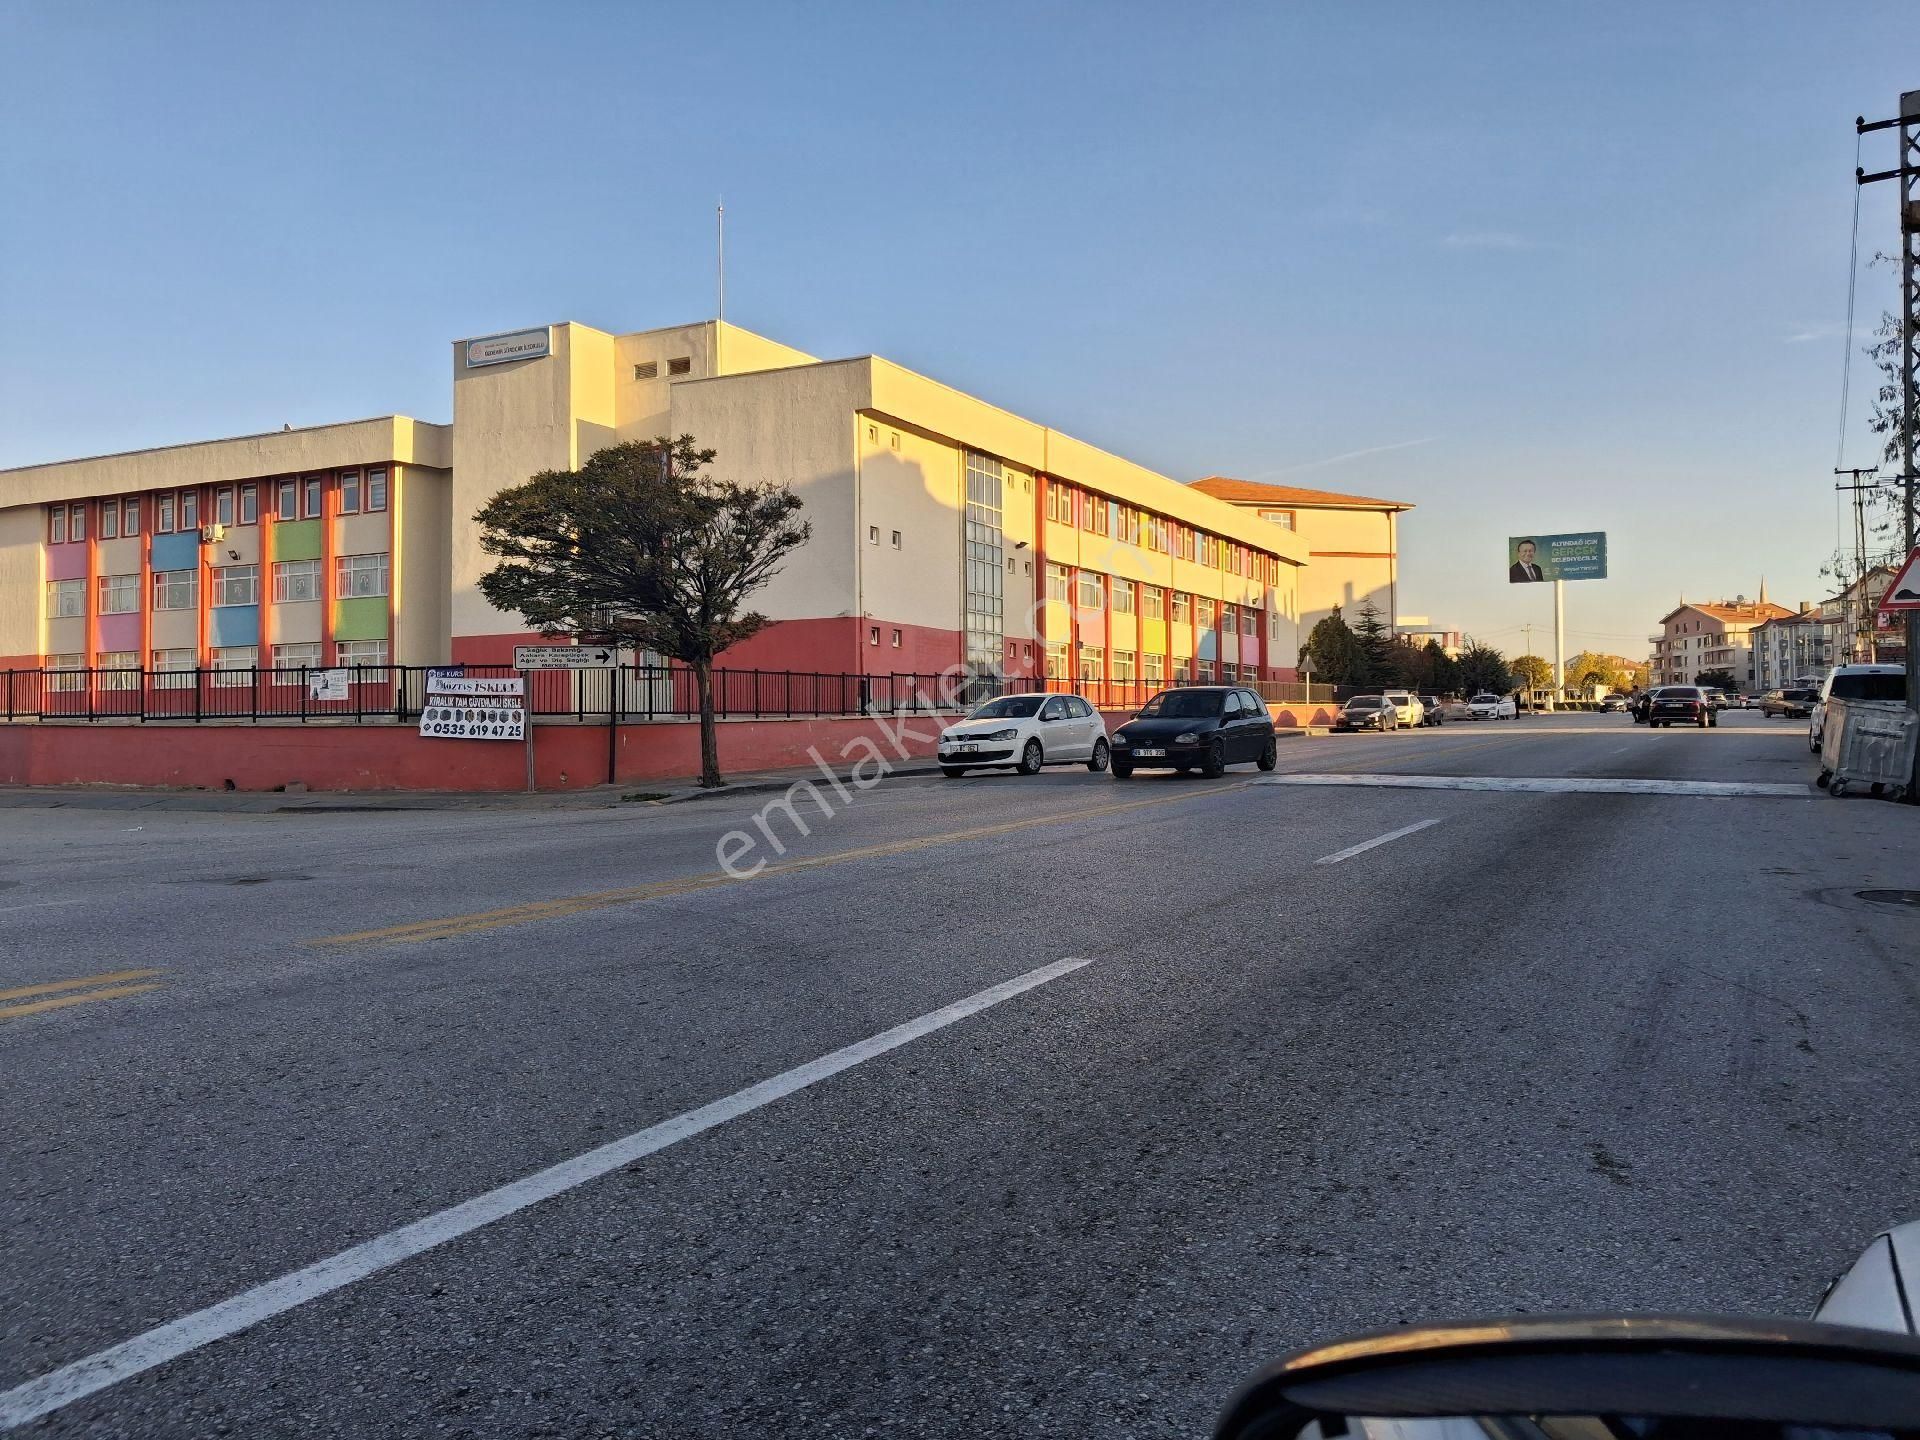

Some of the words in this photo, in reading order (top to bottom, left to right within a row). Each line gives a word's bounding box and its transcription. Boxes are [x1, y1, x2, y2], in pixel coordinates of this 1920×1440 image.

[474, 680, 518, 693] İSKELE
[433, 723, 466, 735] 0535
[468, 724, 489, 736] 619
[491, 725, 505, 737] 47
[507, 725, 522, 737] 25
